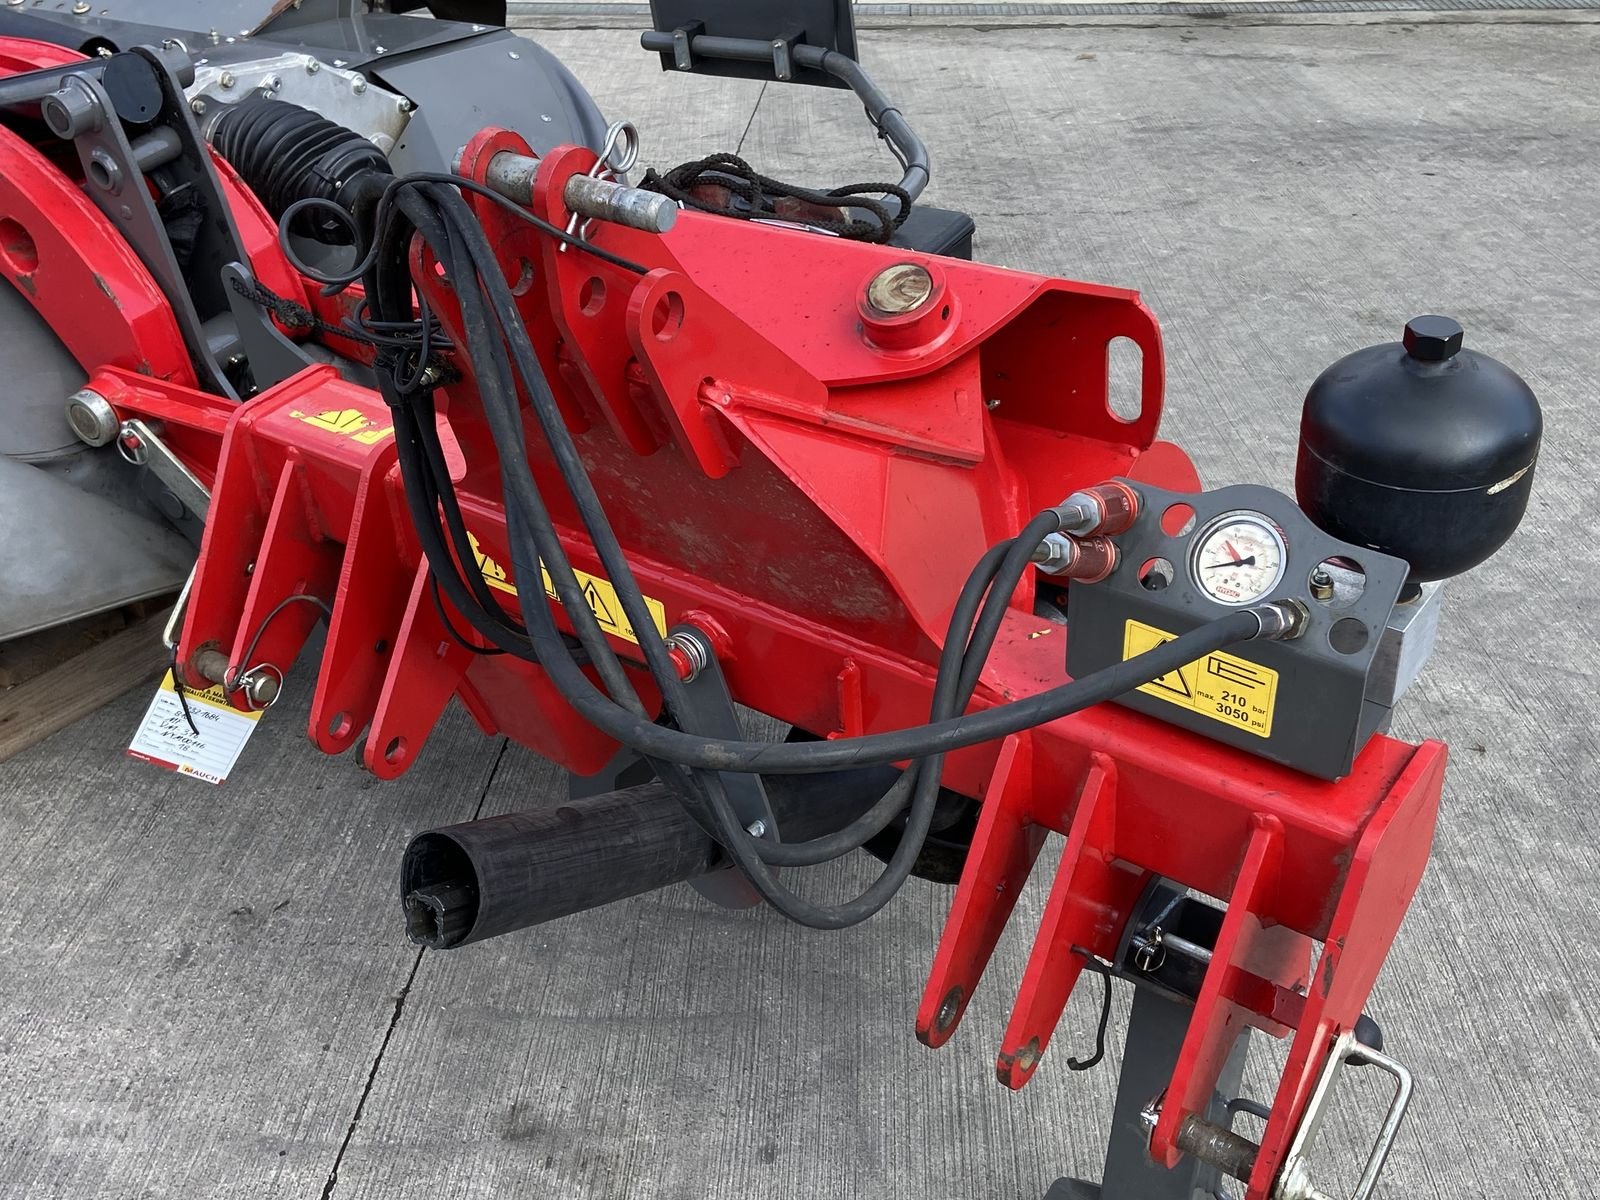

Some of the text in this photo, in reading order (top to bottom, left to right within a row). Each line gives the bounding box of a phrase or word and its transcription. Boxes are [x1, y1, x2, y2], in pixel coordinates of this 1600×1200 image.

[1197, 690, 1215, 701] max.
[1221, 690, 1266, 715] 210 bar
[1216, 702, 1264, 729] 3050 psi
[184, 767, 218, 782] MAUCH
